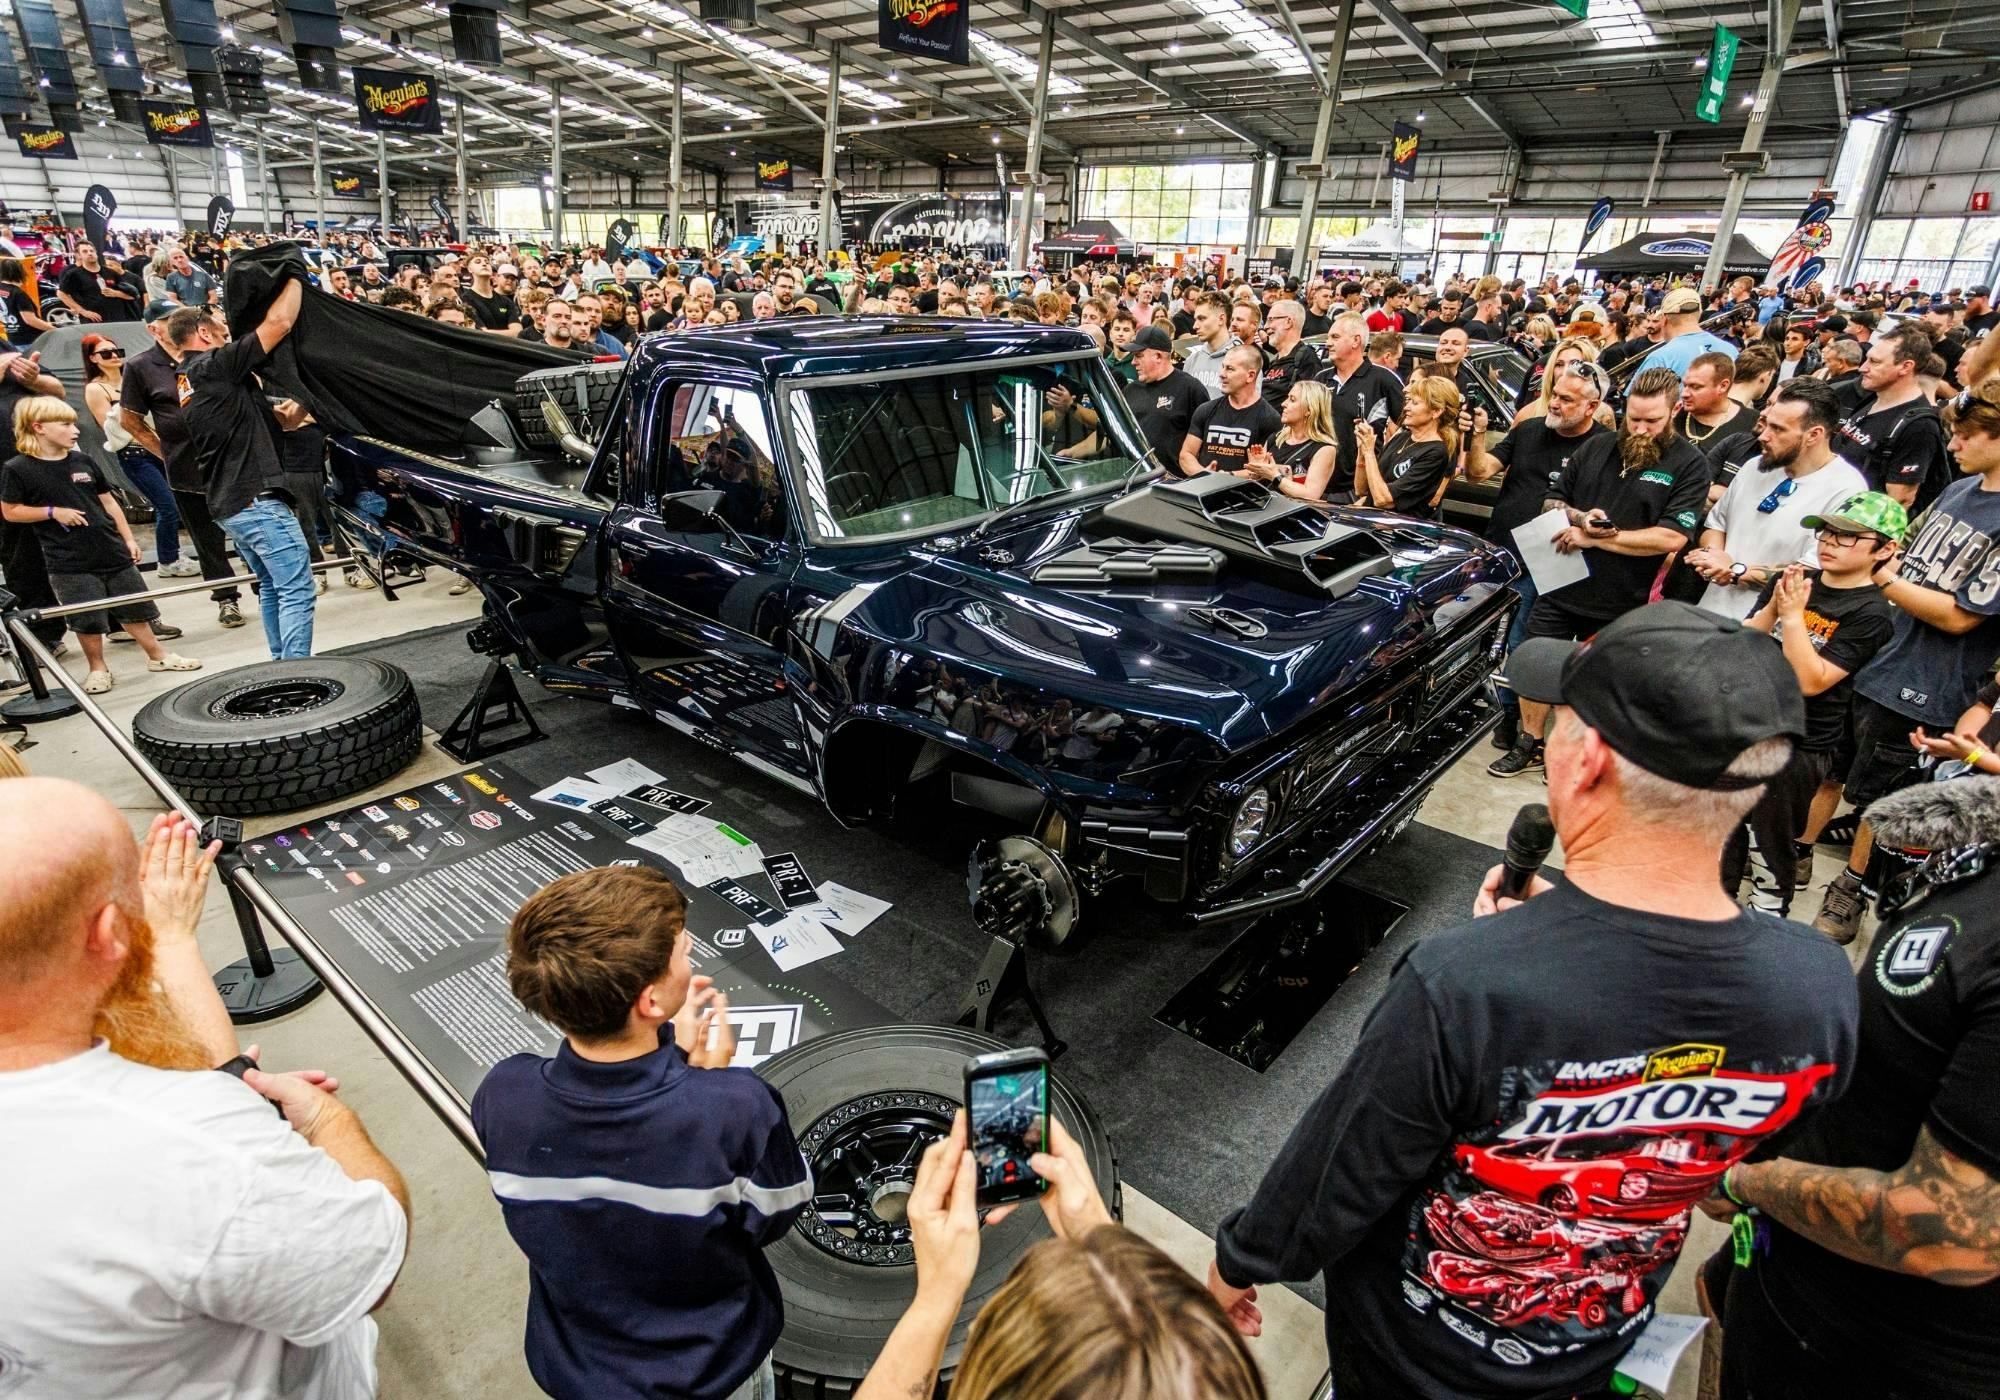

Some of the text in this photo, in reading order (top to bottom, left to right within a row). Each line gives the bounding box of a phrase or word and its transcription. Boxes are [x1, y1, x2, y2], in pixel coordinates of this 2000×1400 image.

[899, 33, 950, 51] Reflect Your Passion
[363, 79, 429, 113] Meguiar's
[914, 208, 956, 221] CASTLEMAINE
[933, 218, 991, 247] SHOP
[1652, 1047, 1717, 1078] Meguiar's
